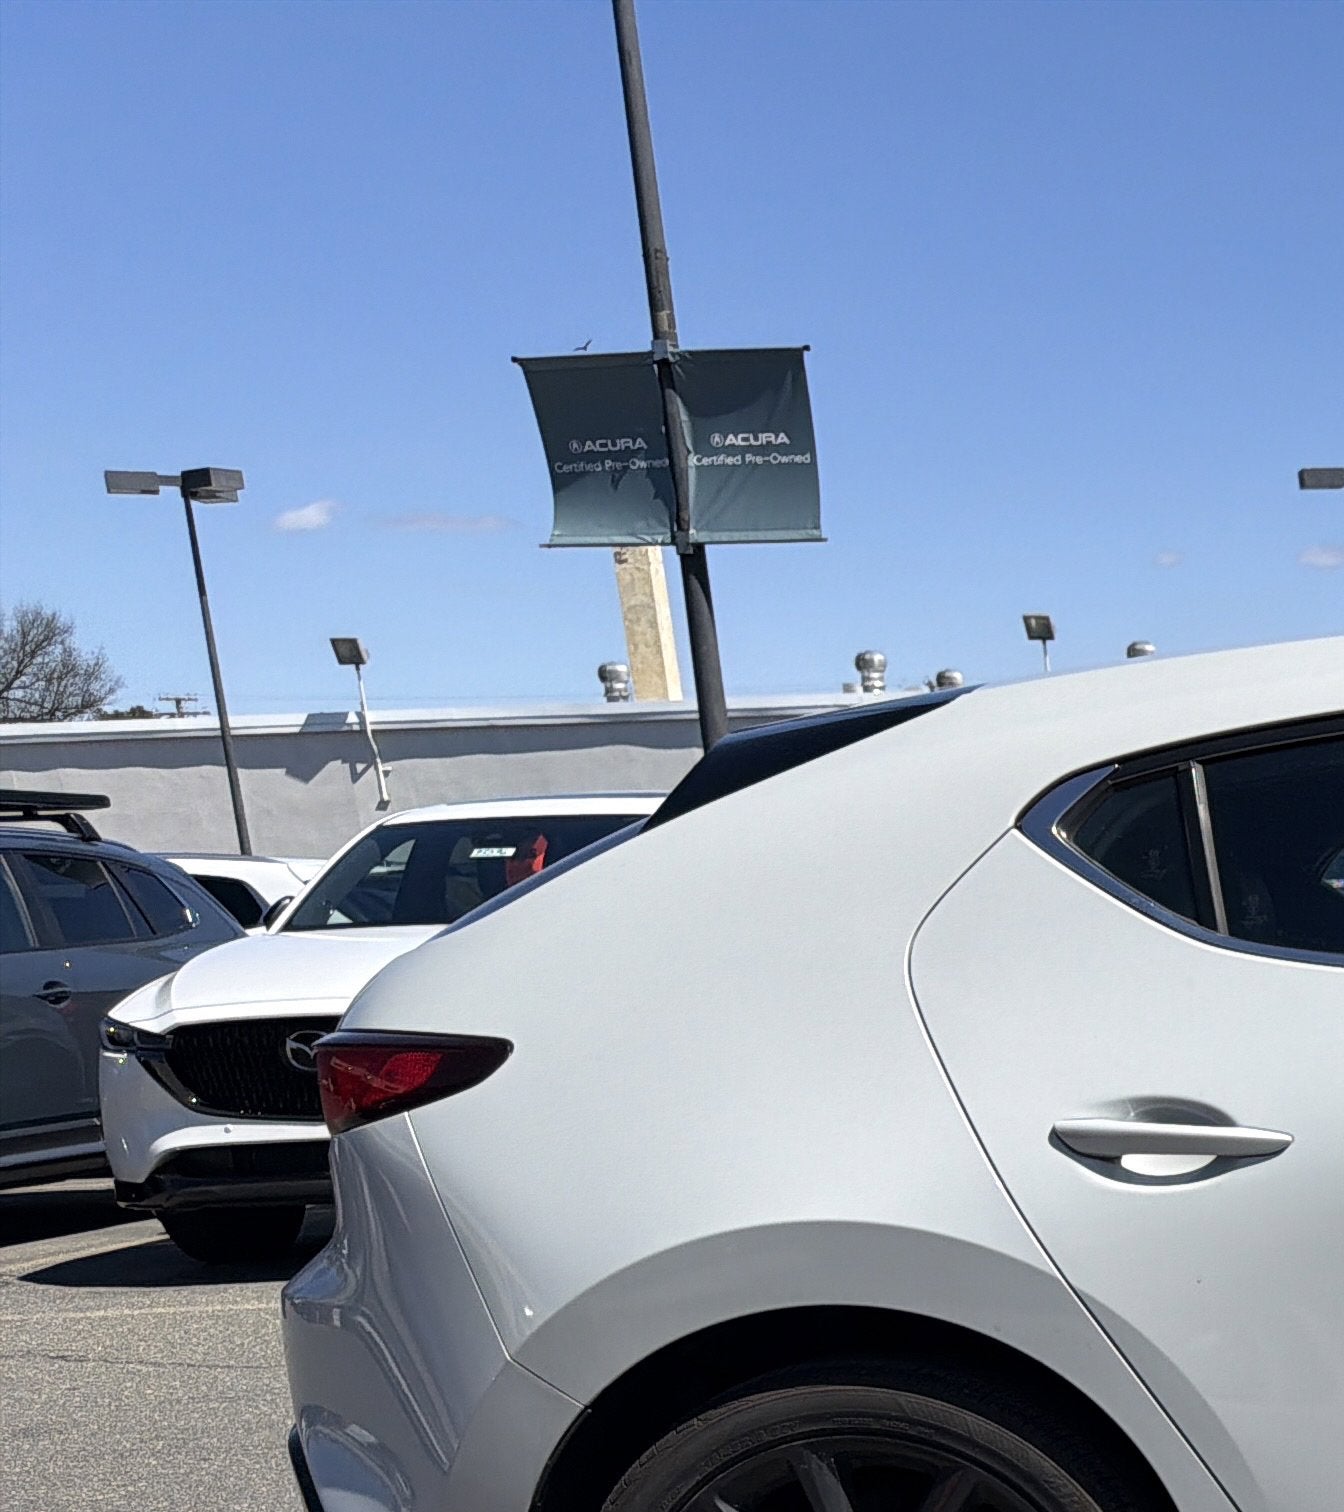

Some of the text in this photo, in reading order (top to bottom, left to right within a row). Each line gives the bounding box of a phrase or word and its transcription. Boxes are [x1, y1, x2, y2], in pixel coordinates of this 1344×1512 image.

[582, 438, 648, 453] ACURA
[724, 432, 790, 447] ACURA
[554, 457, 669, 474] Certified Pre-Owned
[693, 451, 811, 466] Certified Pre-Owned
